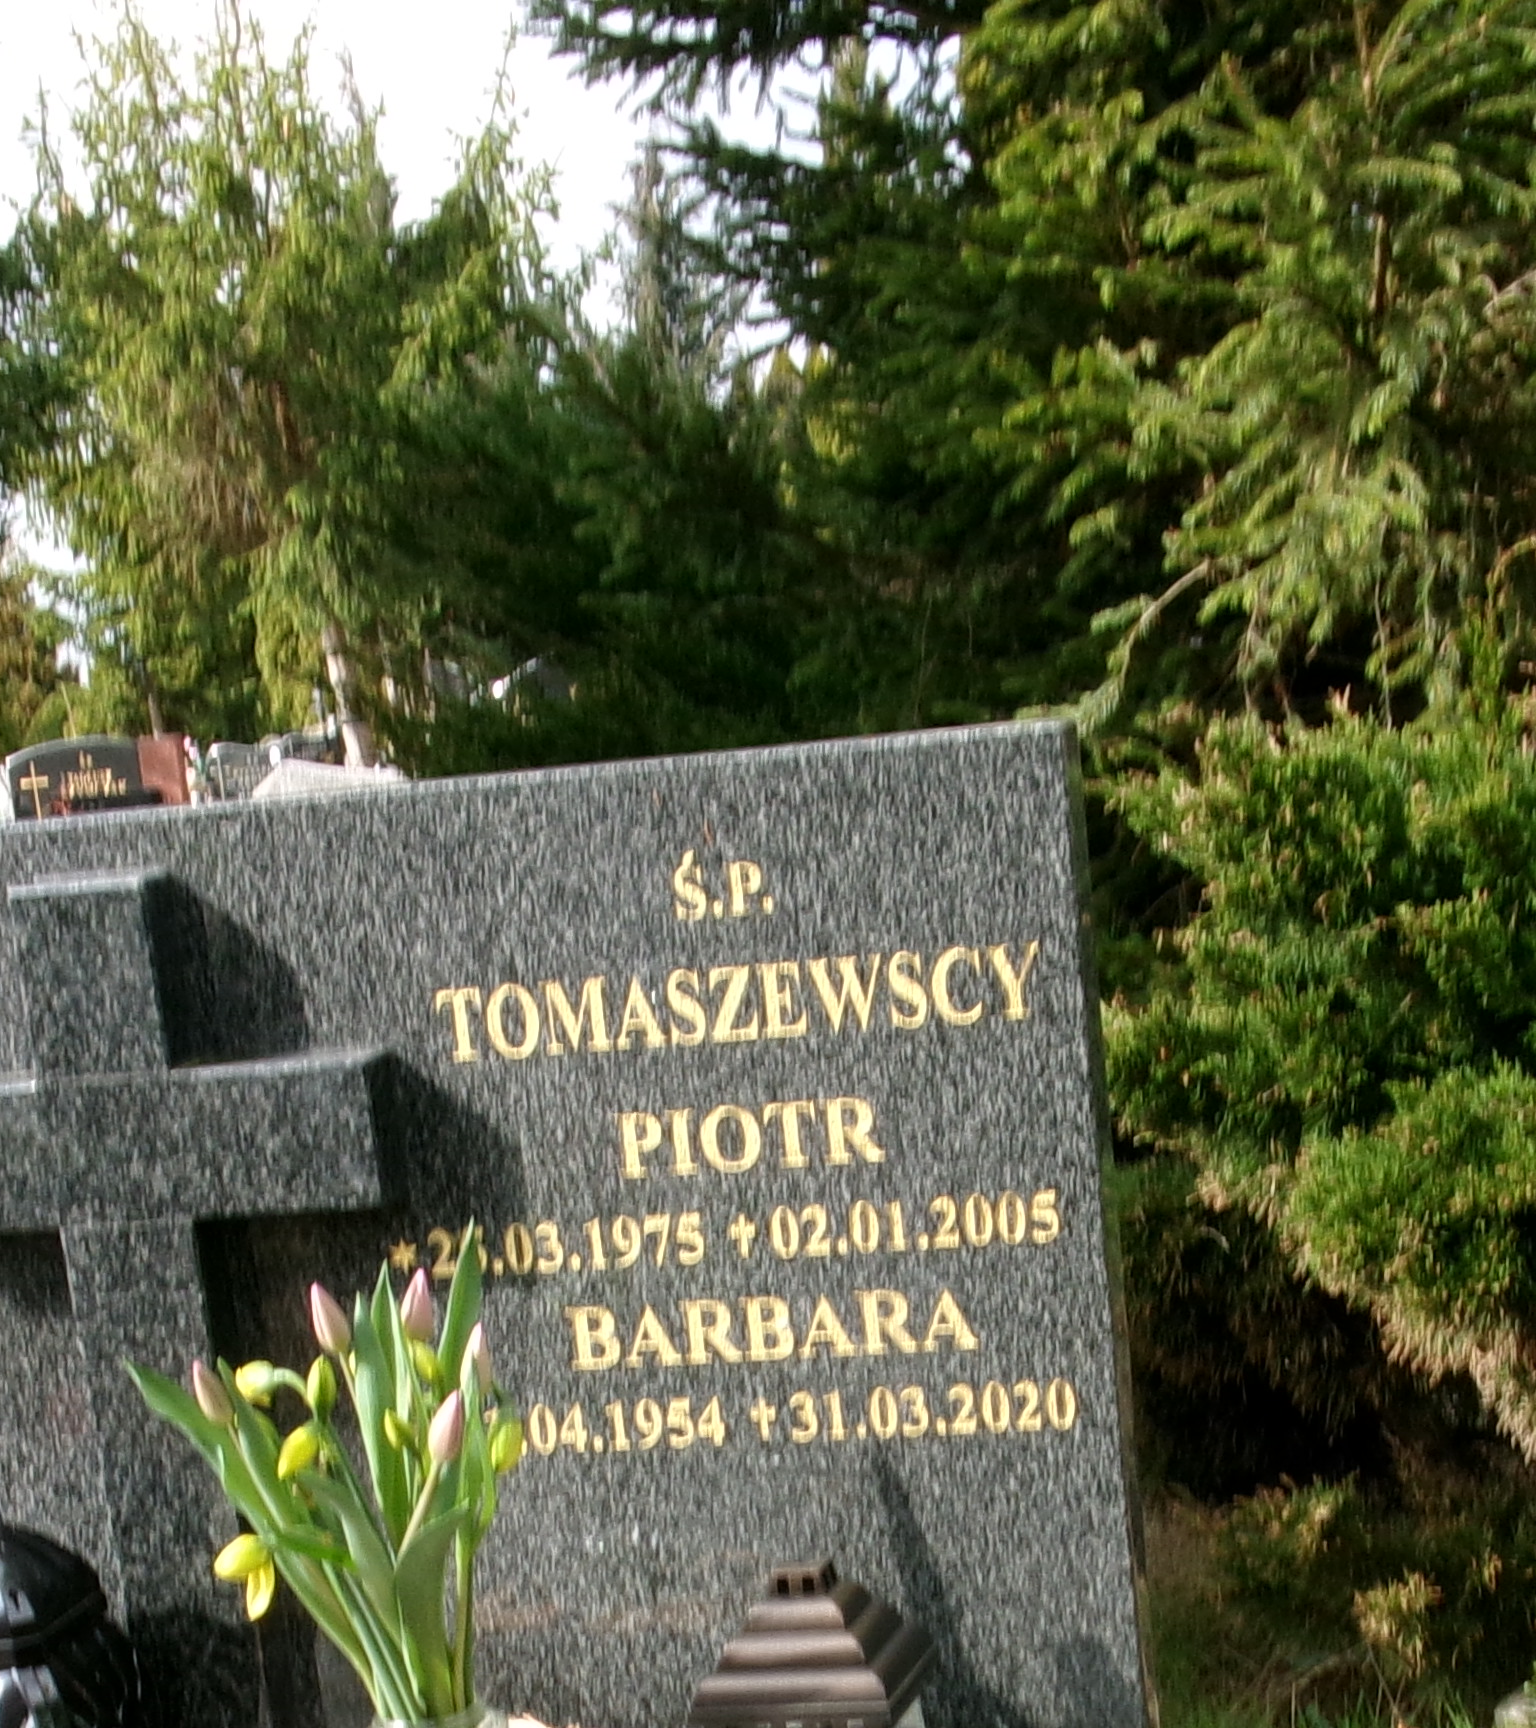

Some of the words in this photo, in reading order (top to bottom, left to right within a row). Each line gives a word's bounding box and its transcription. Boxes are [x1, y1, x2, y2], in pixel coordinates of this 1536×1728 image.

[436, 940, 1040, 1063] TOMASZEWSCY
[617, 1097, 886, 1180] PIOTR
[565, 1290, 979, 1371] BARBARA
